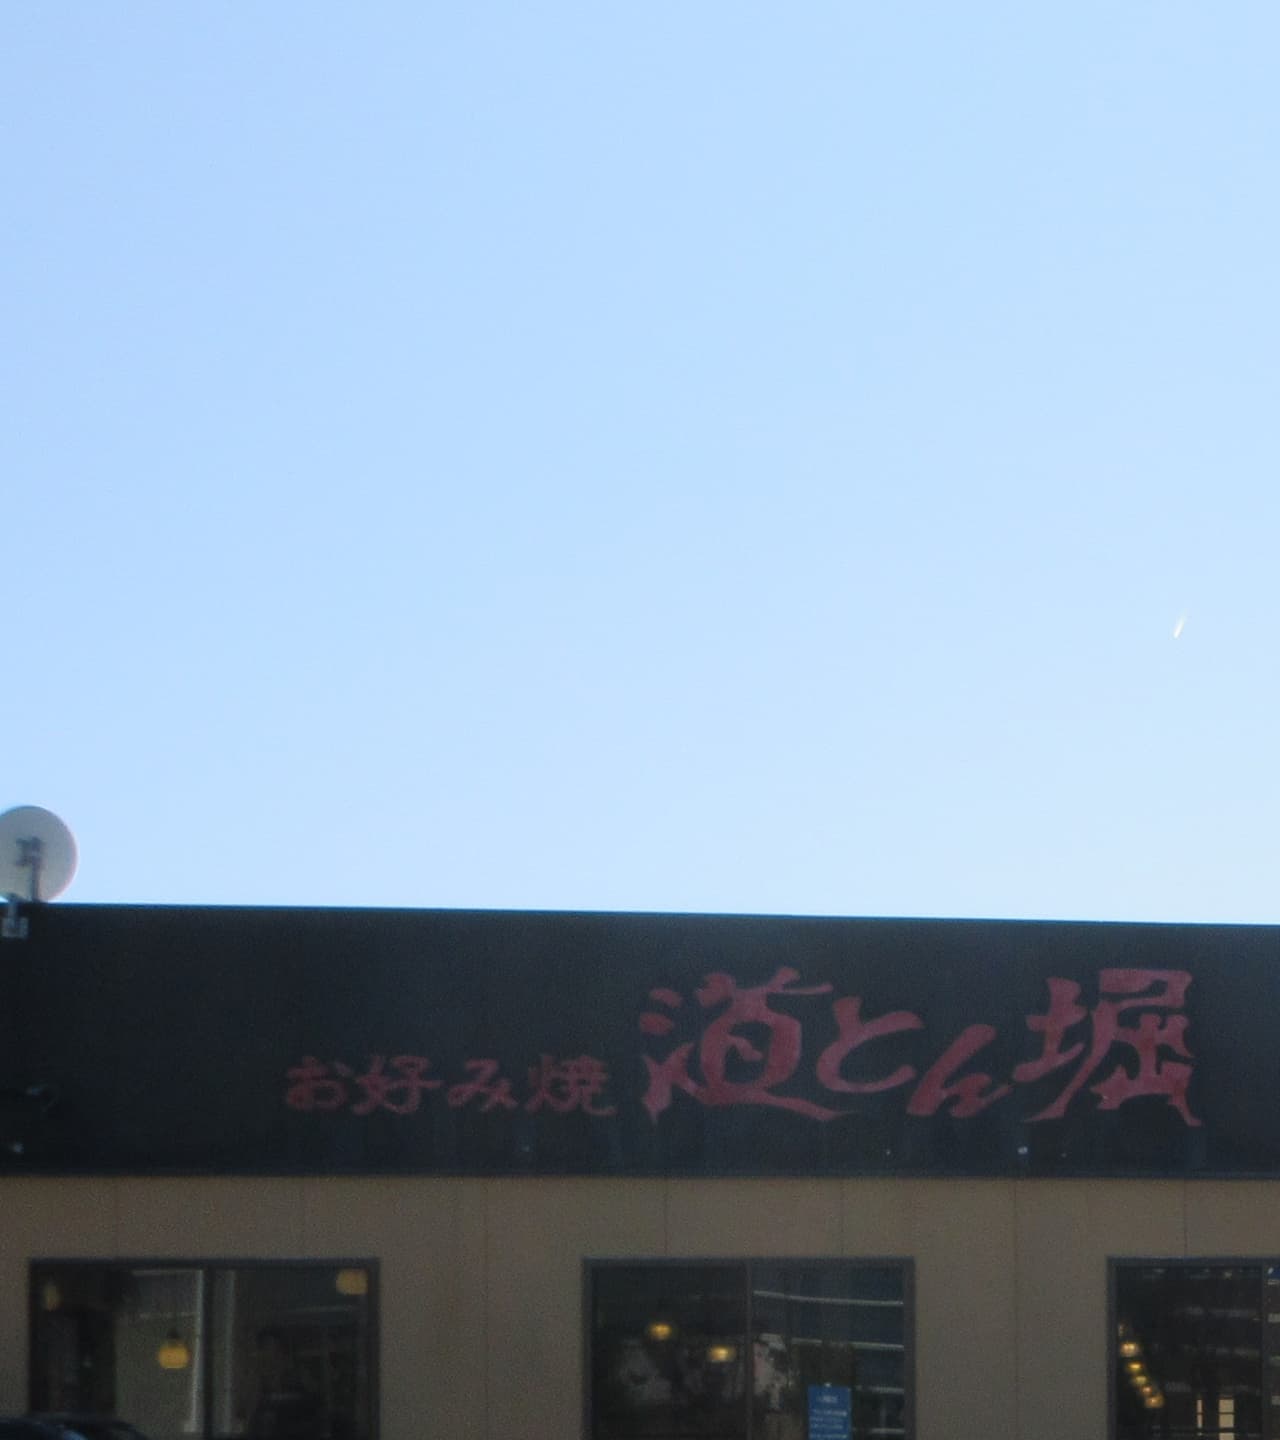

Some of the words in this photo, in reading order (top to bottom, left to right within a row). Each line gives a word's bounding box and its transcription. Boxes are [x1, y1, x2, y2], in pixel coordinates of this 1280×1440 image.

[284, 1054, 617, 1115] お好み焼
[638, 966, 1203, 1126] 道とん堀
